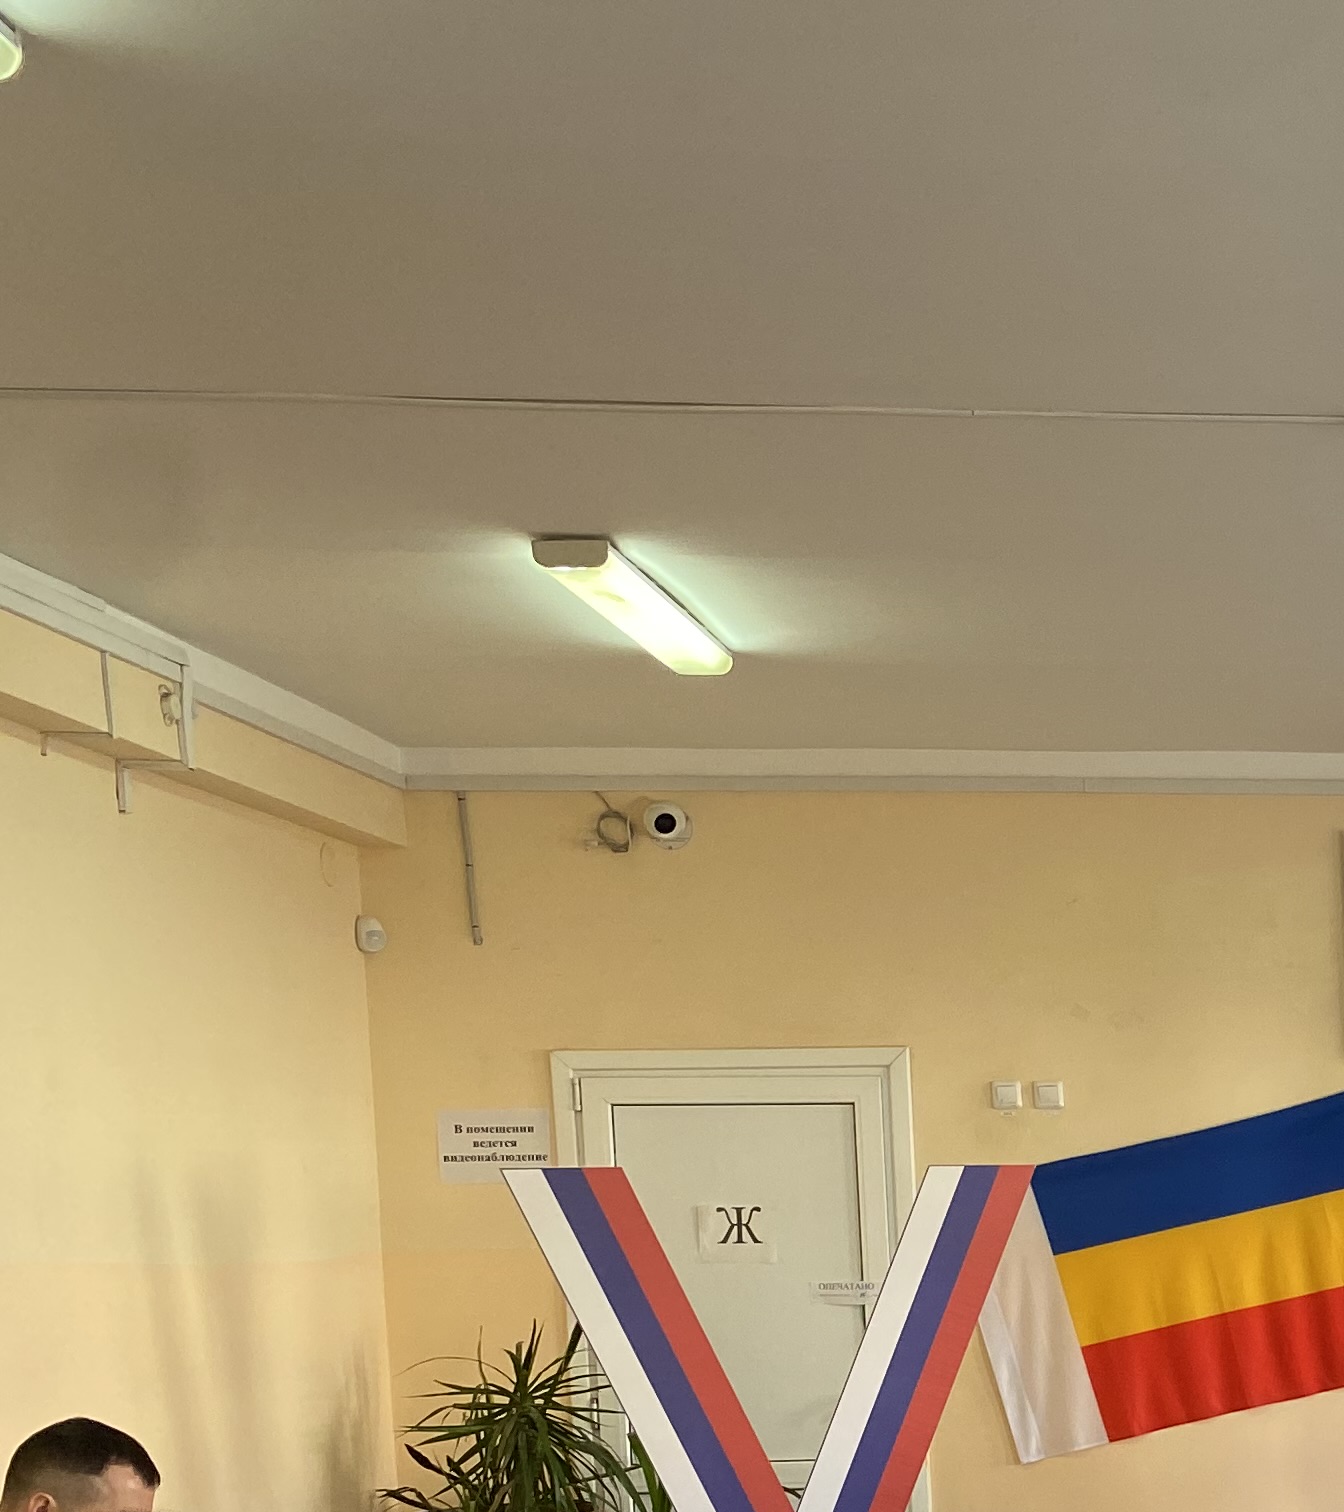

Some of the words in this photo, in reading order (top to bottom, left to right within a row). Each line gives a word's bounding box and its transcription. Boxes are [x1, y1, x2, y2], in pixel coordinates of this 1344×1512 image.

[454, 1124, 463, 1134] В
[466, 1125, 535, 1134] помещении
[472, 1140, 517, 1148] ведется
[443, 1152, 549, 1163] видеонаблюдение
[716, 1206, 763, 1244] Ж
[818, 1282, 875, 1291] ОПЕЧАТАНО
